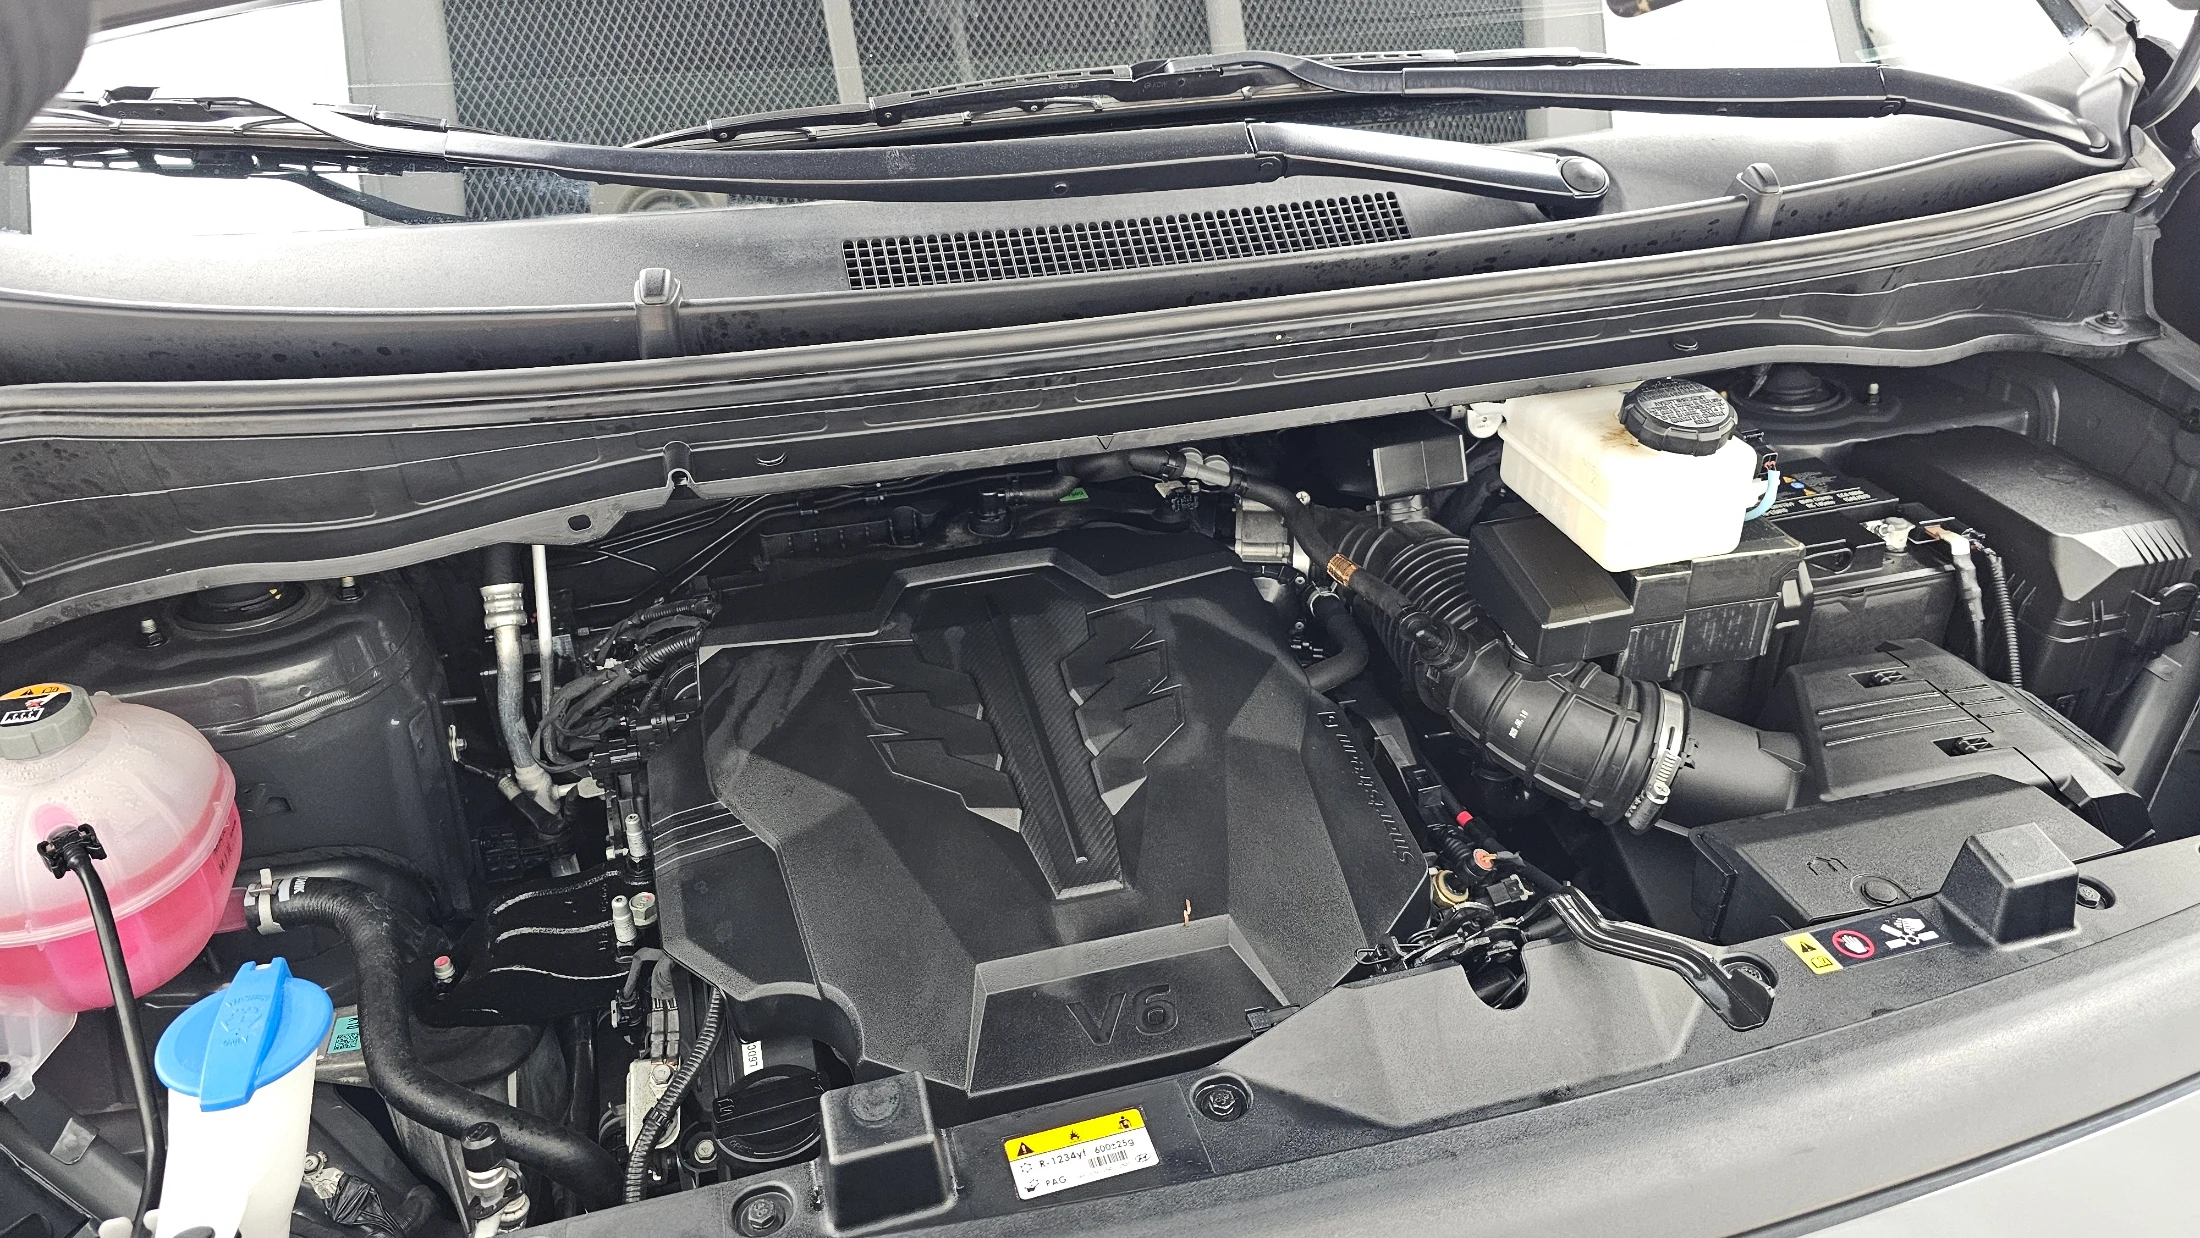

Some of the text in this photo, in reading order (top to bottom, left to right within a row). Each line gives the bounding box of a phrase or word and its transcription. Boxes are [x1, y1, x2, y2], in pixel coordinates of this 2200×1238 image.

[1334, 732, 1415, 864] Smartstream
[1065, 983, 1179, 1046] V6
[1045, 1176, 1067, 1187] PAG
